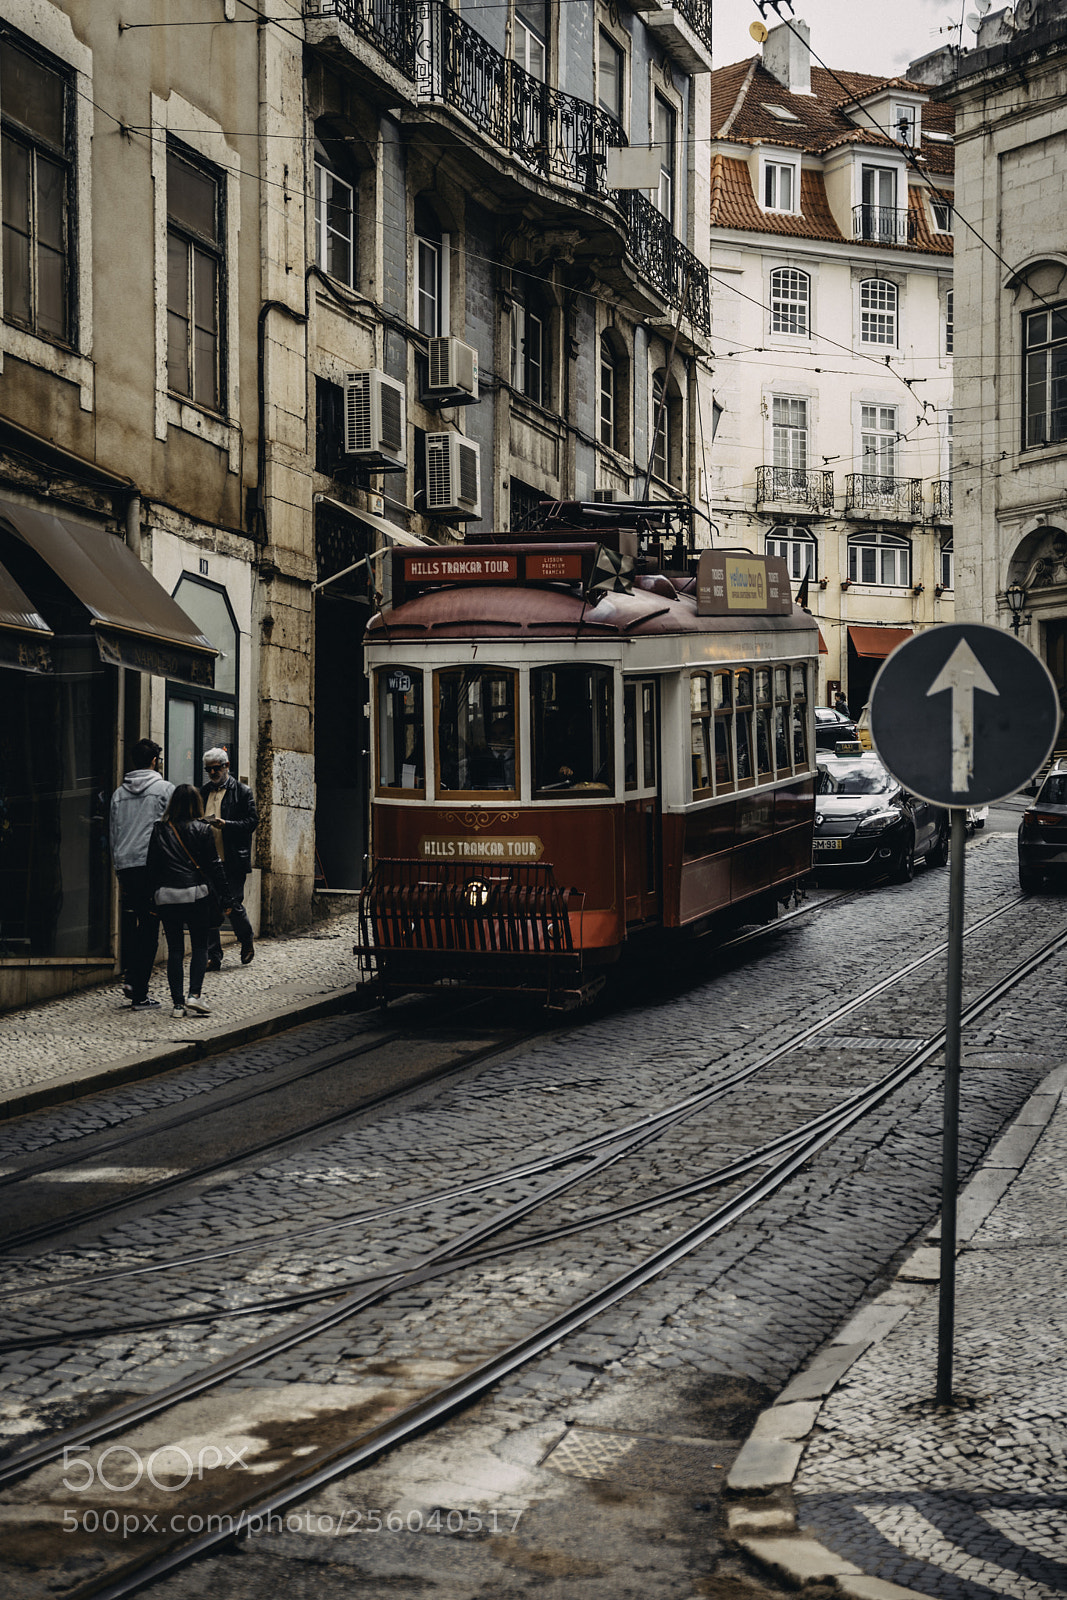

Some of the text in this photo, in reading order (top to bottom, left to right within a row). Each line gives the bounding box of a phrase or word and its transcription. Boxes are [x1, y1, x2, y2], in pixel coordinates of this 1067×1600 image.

[411, 560, 510, 575] HILLS TRAMCAR TOUR
[470, 645, 479, 659] 7
[424, 841, 537, 856] HILLS TRAMCAR TOUR
